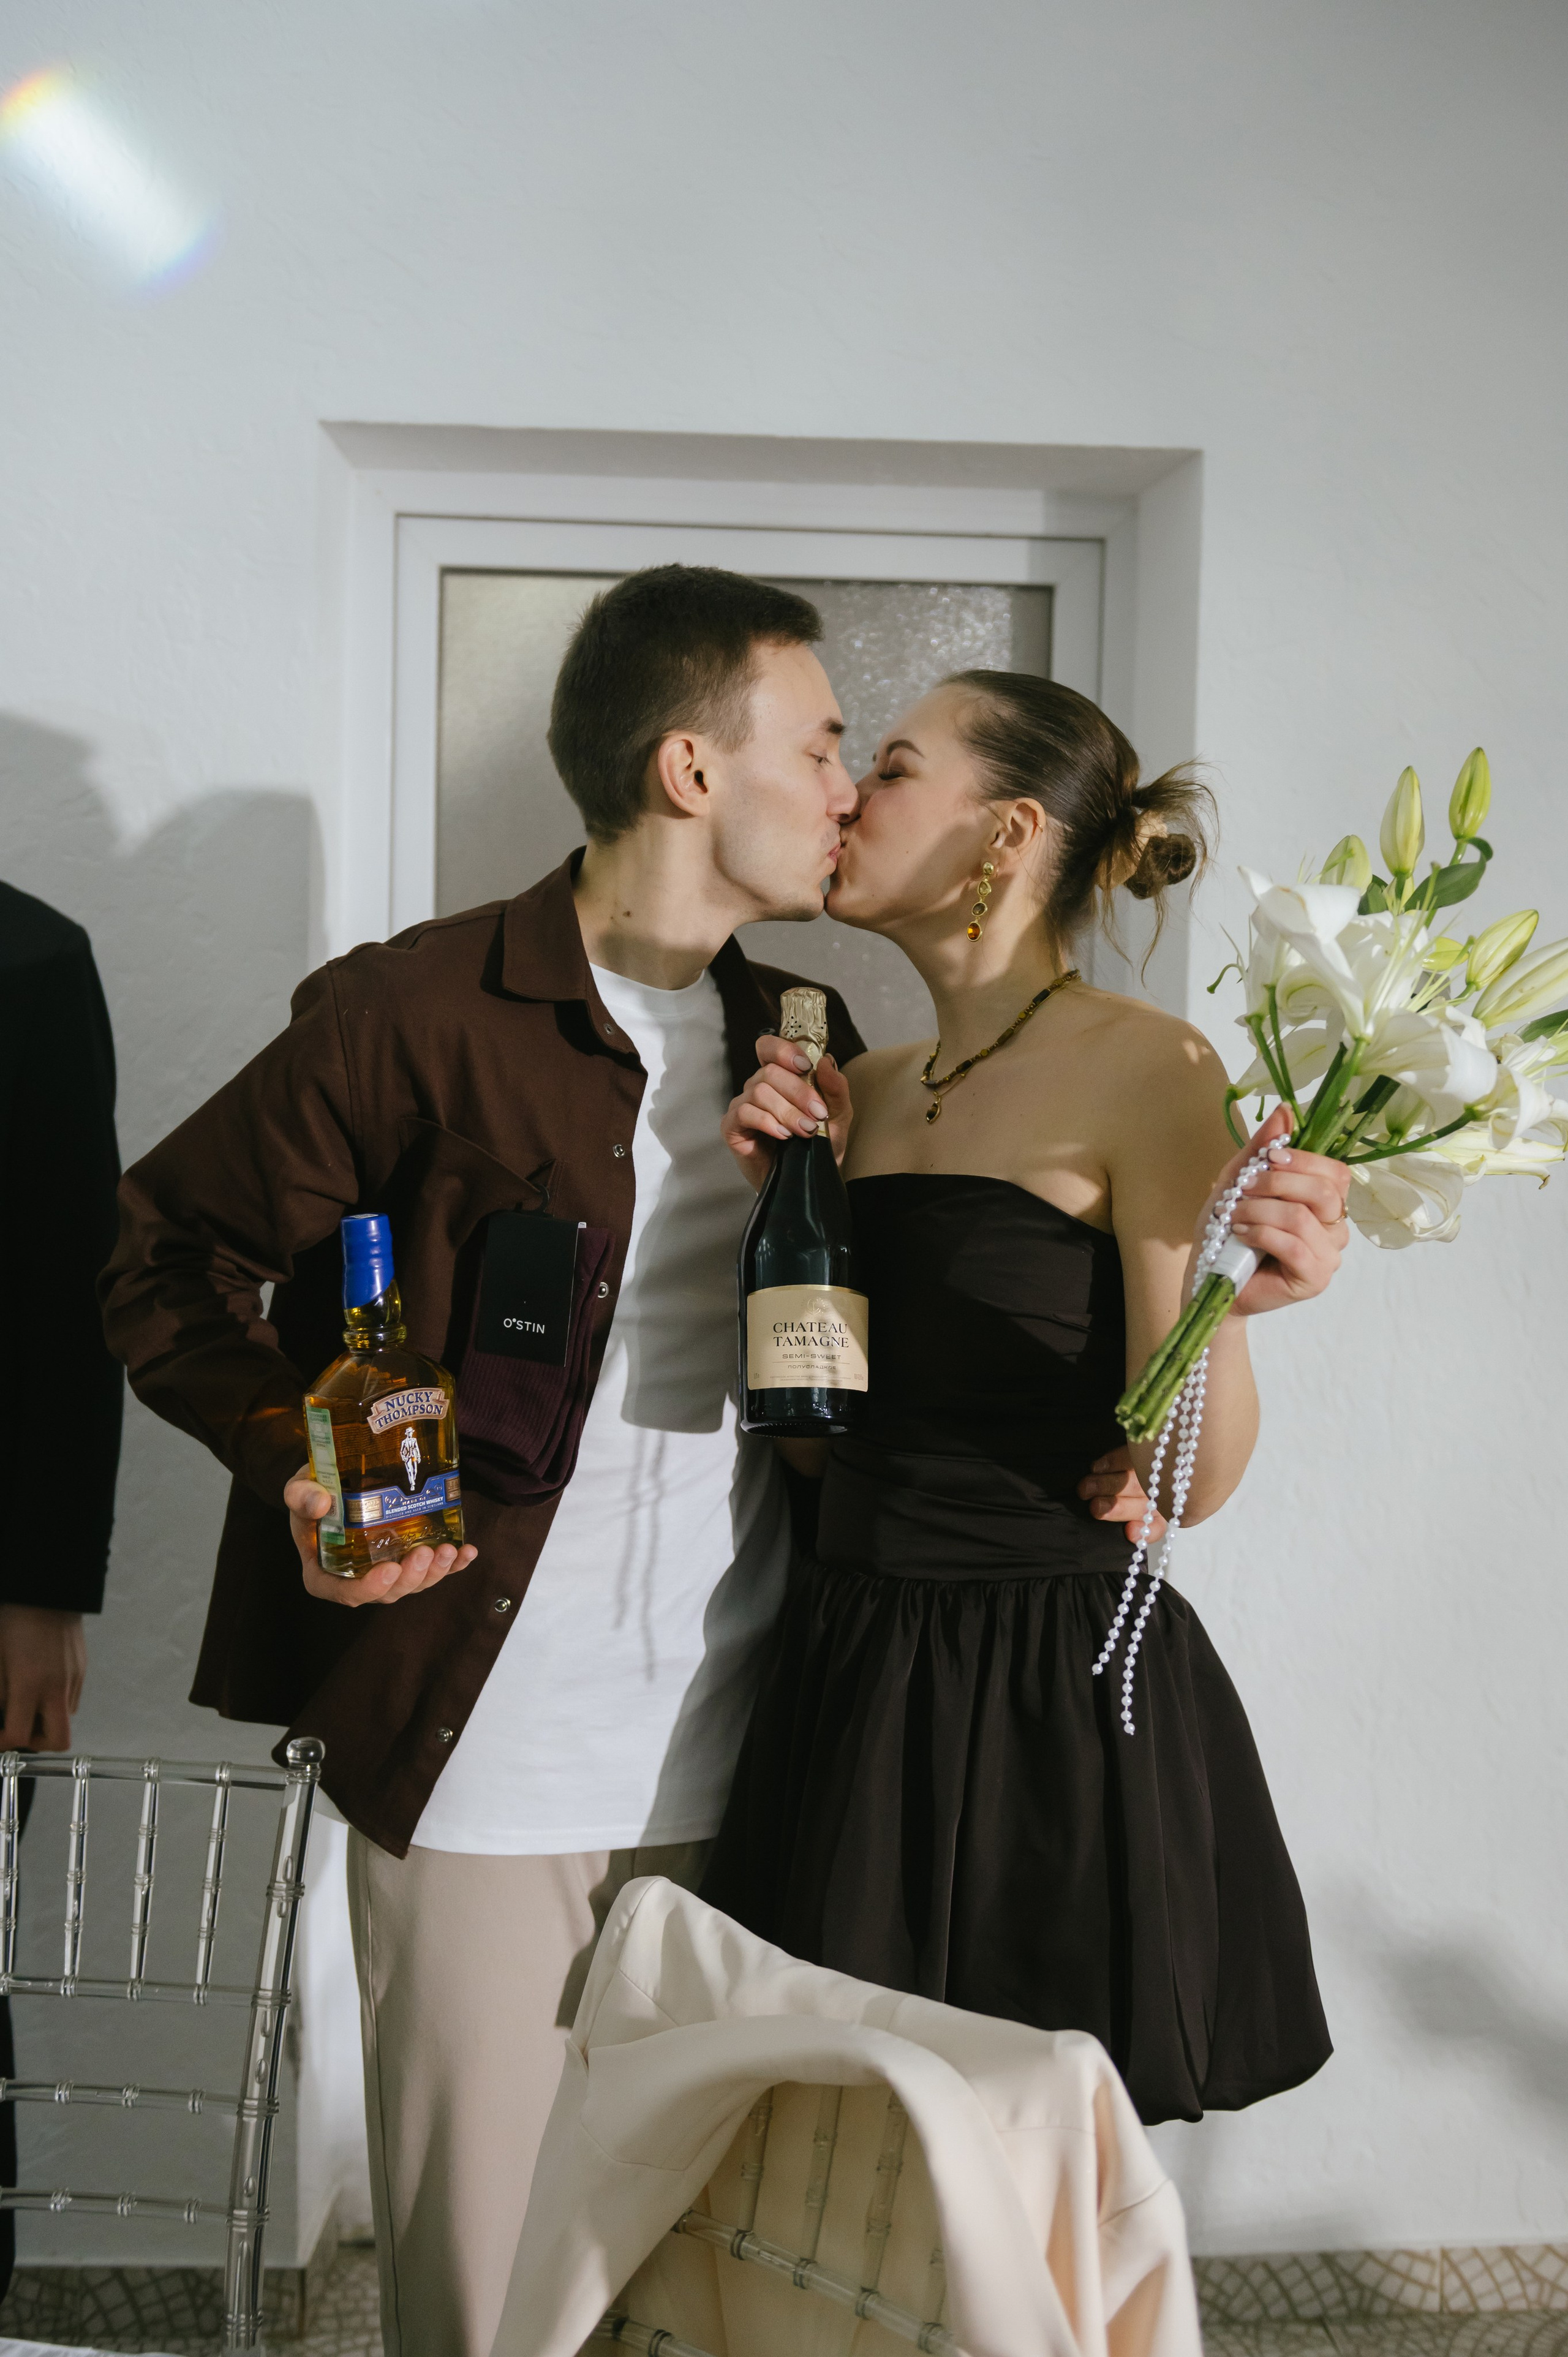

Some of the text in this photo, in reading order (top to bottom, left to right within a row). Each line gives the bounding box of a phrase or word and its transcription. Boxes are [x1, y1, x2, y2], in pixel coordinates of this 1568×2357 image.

[773, 1322, 848, 1334] CHATEAU
[773, 1336, 850, 1348] TAMAGNE
[385, 1392, 433, 1411] NUCKY
[375, 1404, 443, 1428] THOMPSON
[385, 1505, 407, 1515] BLENDED
[426, 1496, 443, 1505] WHISKY
